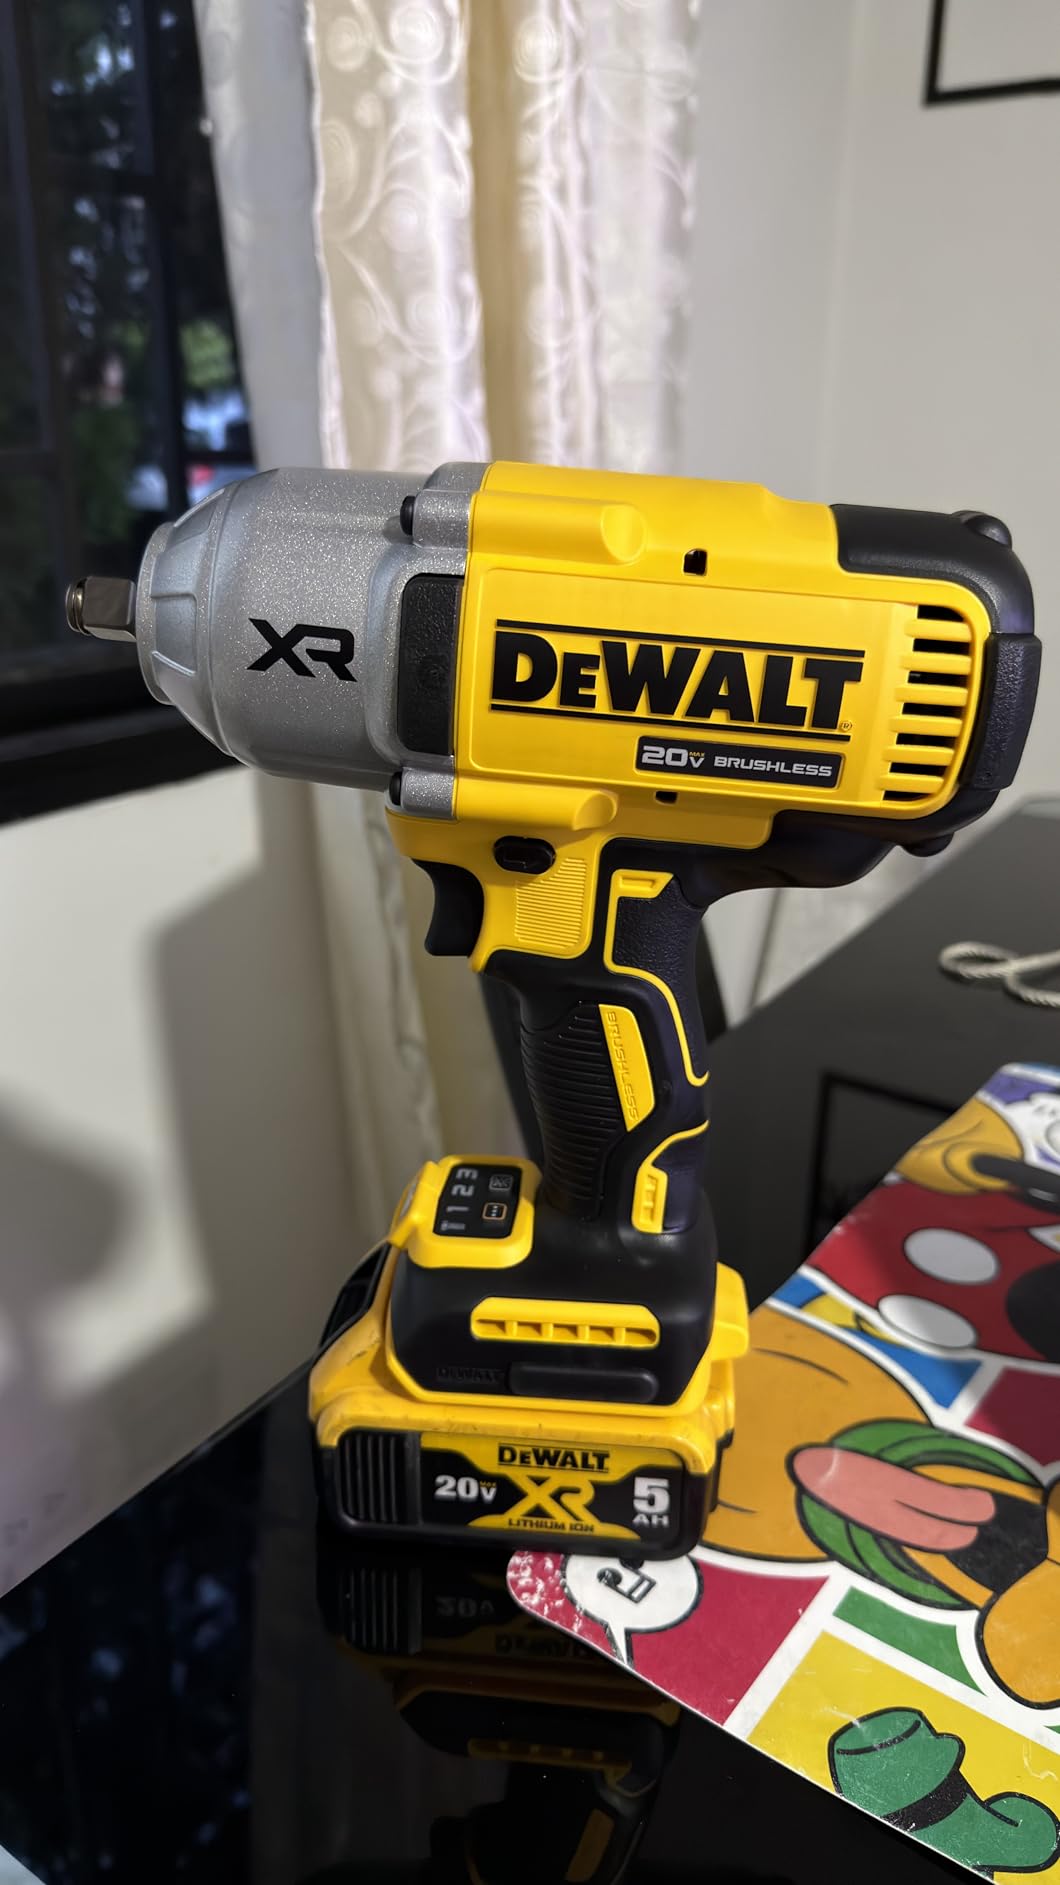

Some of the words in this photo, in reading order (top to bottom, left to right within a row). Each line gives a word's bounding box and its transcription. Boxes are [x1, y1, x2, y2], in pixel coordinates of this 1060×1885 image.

[246, 617, 358, 683] XR
[713, 756, 833, 777] BRUSHLESS
[607, 1011, 639, 1121] BRUSHLESS
[455, 1168, 478, 1180] 3
[450, 1184, 475, 1197] 2
[504, 1472, 602, 1522] XR
[632, 1476, 670, 1515] 5
[508, 1518, 566, 1531] LITHIUM
[569, 1522, 595, 1533] ION
[632, 1513, 670, 1528] AH
